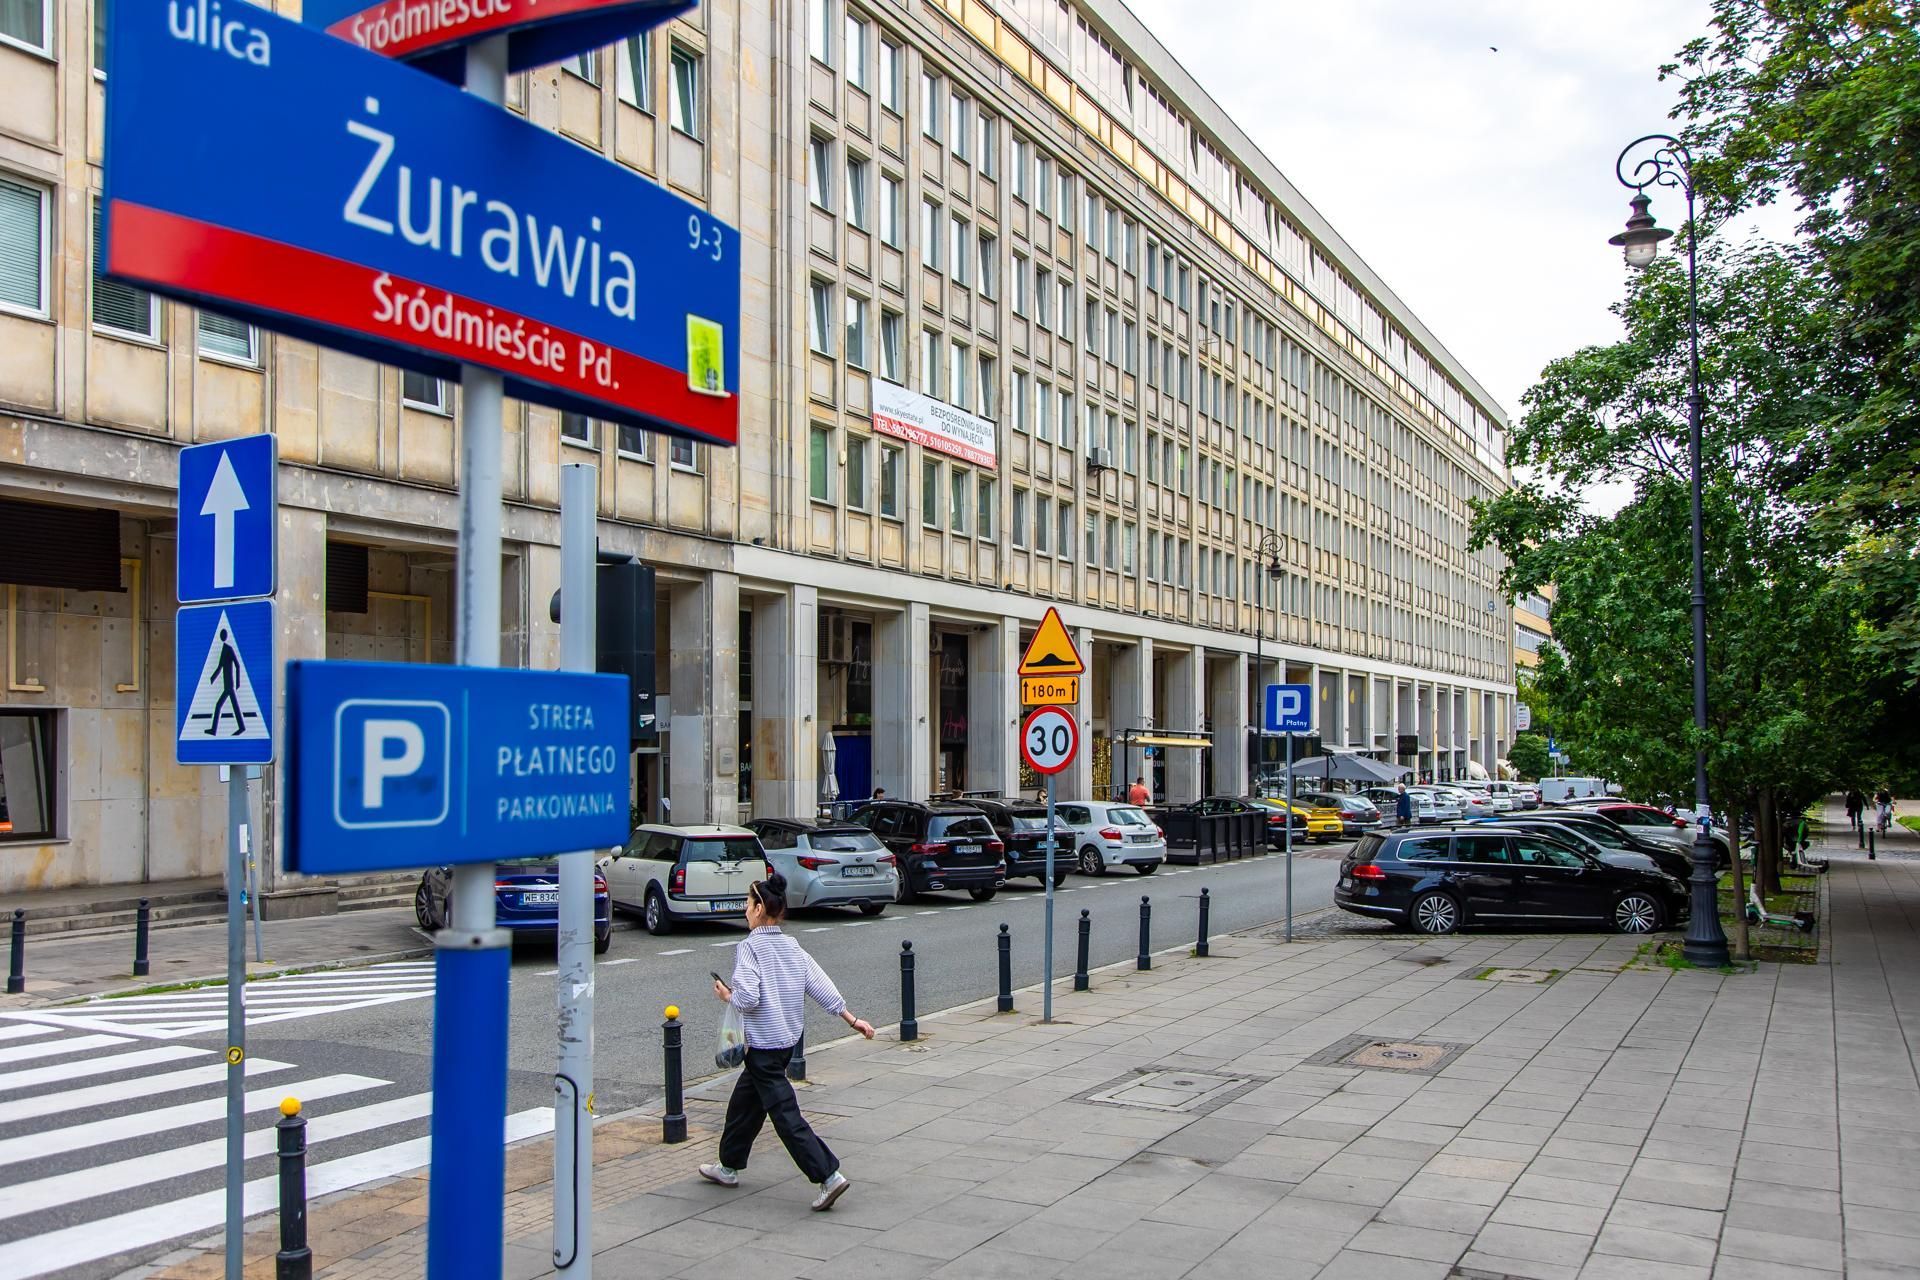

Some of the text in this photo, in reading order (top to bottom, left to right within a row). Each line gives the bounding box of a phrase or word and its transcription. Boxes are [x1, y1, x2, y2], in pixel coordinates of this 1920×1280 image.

[169, 0, 270, 66] ulica
[343, 96, 637, 321] Żurawia
[689, 214, 721, 261] 9-3
[373, 272, 620, 390] Śródmieście Pd.
[941, 421, 951, 433] DO
[529, 703, 594, 730] STREFA
[1276, 690, 1301, 726] P
[1030, 725, 1070, 756] 30
[362, 720, 424, 808] P
[497, 745, 616, 777] PŁATNEGO
[497, 793, 616, 822] PARKOWANIA
